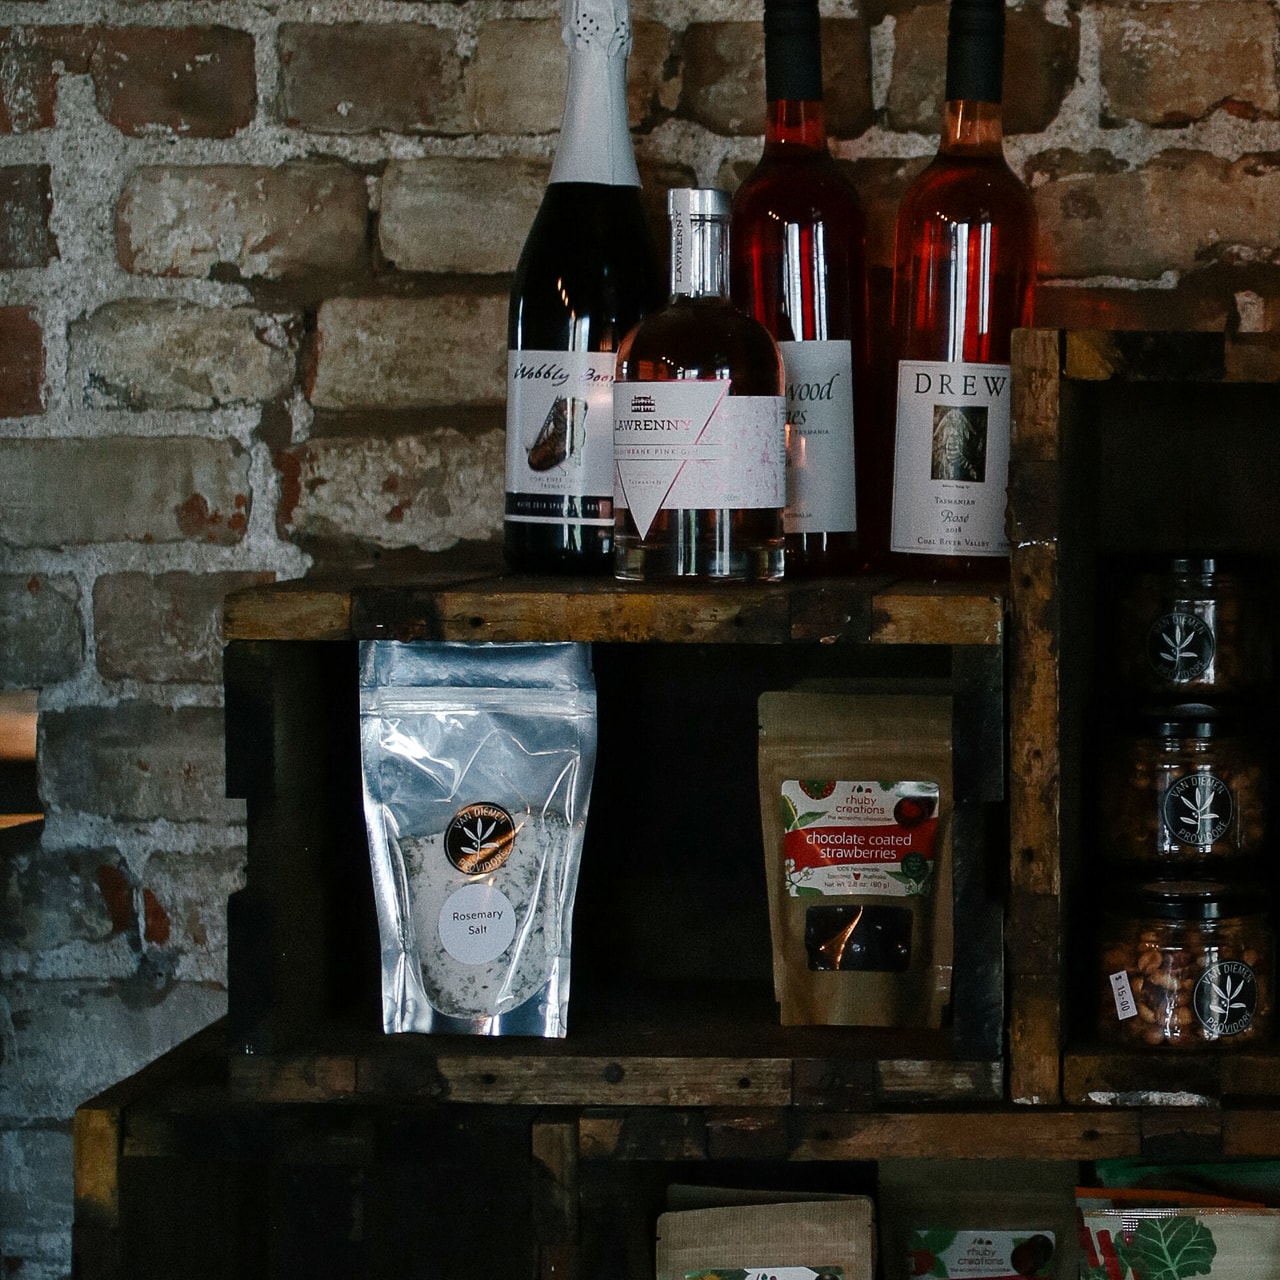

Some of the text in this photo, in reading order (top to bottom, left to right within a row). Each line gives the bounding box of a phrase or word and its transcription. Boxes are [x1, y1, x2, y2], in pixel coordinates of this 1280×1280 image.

[676, 210, 684, 283] LAWRENNY
[514, 363, 570, 386] Wobbly
[914, 373, 1008, 398] DREW
[614, 419, 692, 431] LAWRENNY
[1172, 616, 1205, 635] DIEMEN
[1170, 776, 1225, 798] VAN DIEMEN
[835, 804, 885, 815] creations
[845, 795, 877, 807] rhuby
[454, 807, 508, 830] VAN DIEMEN
[806, 831, 912, 846] chocolate coated
[1178, 819, 1228, 843] PROVIDORE
[458, 848, 509, 873] PROVIDORE
[819, 846, 897, 860] strawberries
[452, 910, 504, 922] Rosemary
[468, 925, 488, 936] Salt
[1202, 963, 1254, 985] VAN DIEMEN
[1206, 1010, 1252, 1033] PROVIDORE
[957, 1256, 1004, 1266] creations
[966, 1247, 997, 1257] rhuby
